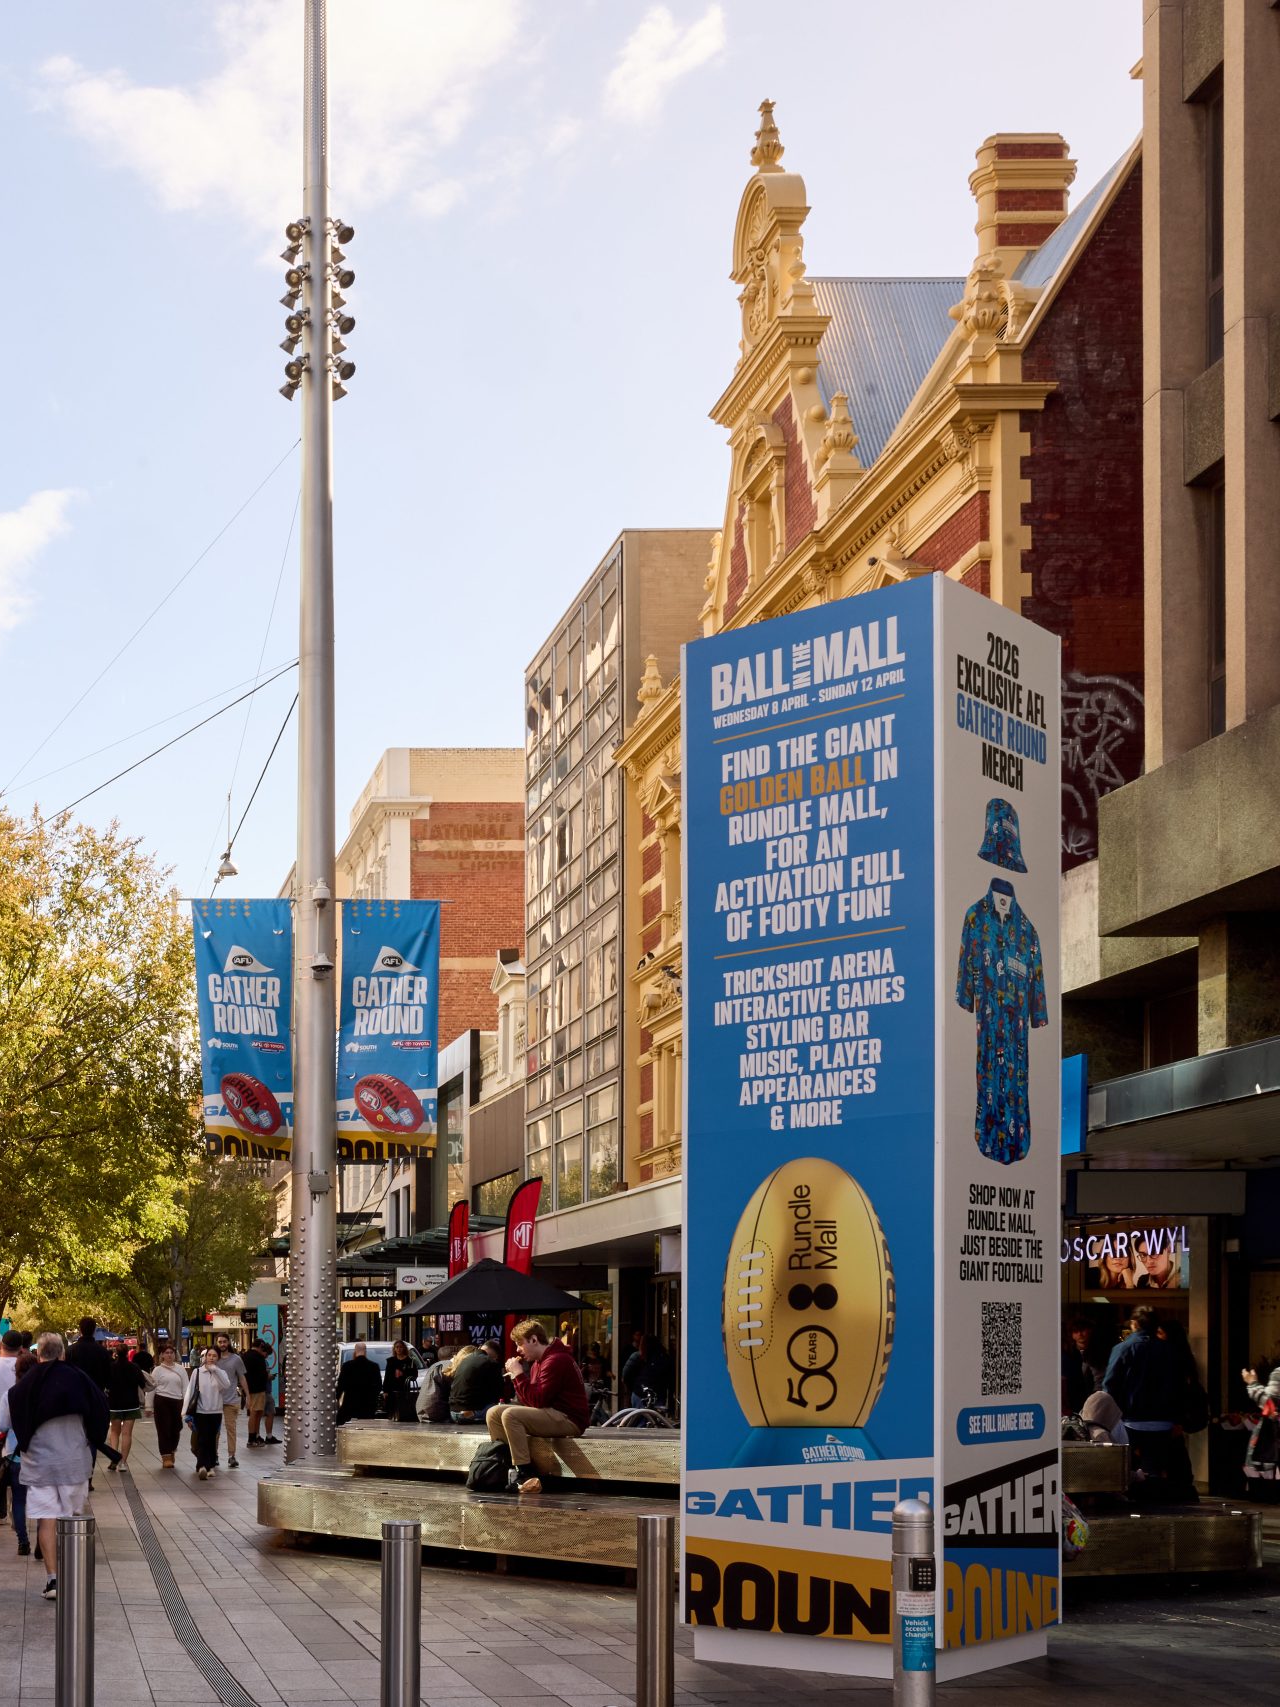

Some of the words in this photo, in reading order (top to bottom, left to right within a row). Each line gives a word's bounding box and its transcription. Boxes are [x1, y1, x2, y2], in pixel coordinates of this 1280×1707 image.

[792, 640, 811, 671] THE
[813, 615, 905, 685] MALL
[987, 632, 1019, 679] 2026
[712, 648, 790, 712] BALL
[713, 703, 770, 729] WEDNESDAY
[772, 702, 778, 715] 8
[781, 694, 809, 712] APRIL
[819, 682, 858, 702] SUNDAY
[860, 679, 872, 692] 12
[875, 669, 905, 688] APRIL
[792, 671, 811, 690] IN
[957, 654, 1023, 718] EXCLUSIVE
[1026, 689, 1047, 729] AFL
[722, 744, 770, 783] FIND
[777, 732, 818, 770] THE
[825, 714, 895, 760] GIANT
[957, 692, 1003, 746] GATHER
[1007, 716, 1047, 765] ROUND
[720, 768, 803, 816] GOLDEN
[810, 756, 866, 796] BALL
[873, 748, 898, 782] IN
[982, 742, 1024, 792] MERCH
[728, 799, 812, 846] RUNDLE
[819, 786, 888, 827] MALL,
[765, 835, 807, 871] FOR
[815, 826, 848, 861] AN
[714, 860, 843, 913] ACTIVATION
[851, 849, 904, 888] FULL
[727, 910, 752, 943] OF
[759, 896, 830, 938] FOOTY
[837, 885, 891, 924] FUN!
[234, 956, 253, 965] AFL
[383, 957, 402, 966] AFL
[723, 958, 824, 997] TRICKSHOT
[830, 947, 895, 982] ARENA
[208, 973, 280, 1008] GATHER
[352, 975, 428, 1007] GATHER
[714, 986, 831, 1027] INTERACTIVE
[837, 976, 905, 1010] GAMES
[213, 1003, 278, 1037] ROUND
[353, 1005, 424, 1037] ROUND
[746, 1016, 823, 1050] STYLING
[829, 1010, 869, 1040] BAR
[739, 1047, 804, 1079] MUSIC,
[809, 1038, 881, 1071] PLAYER
[739, 1067, 876, 1106] APPEARANCES
[770, 1105, 784, 1130] &
[790, 1100, 842, 1129] MORE
[969, 1184, 996, 1206] SHOP
[999, 1187, 1021, 1209] NOW
[1023, 1190, 1035, 1209] AT
[788, 1184, 812, 1271] Rundle
[968, 1209, 1006, 1232] RUNDLE
[1008, 1213, 1036, 1236] MALL,
[814, 1220, 838, 1270] Mall
[960, 1235, 986, 1256] JUST
[989, 1236, 1022, 1258] BESIDE
[1025, 1239, 1043, 1259] THE
[344, 1289, 365, 1298] Foot
[367, 1289, 399, 1298] Locker
[959, 1260, 989, 1283] GIANT
[992, 1262, 1043, 1284] FOOTBALL!
[786, 1325, 839, 1412] 50
[808, 1332, 817, 1367] YEARS
[969, 1415, 981, 1434] SEE
[982, 1414, 996, 1433] FULL
[997, 1412, 1018, 1432] RANGE
[1018, 1411, 1034, 1430] HERE
[802, 1445, 837, 1460] GATHER
[837, 1445, 865, 1460] ROUND
[943, 1463, 1059, 1536] GATHER
[943, 1561, 1059, 1649] ROUND
